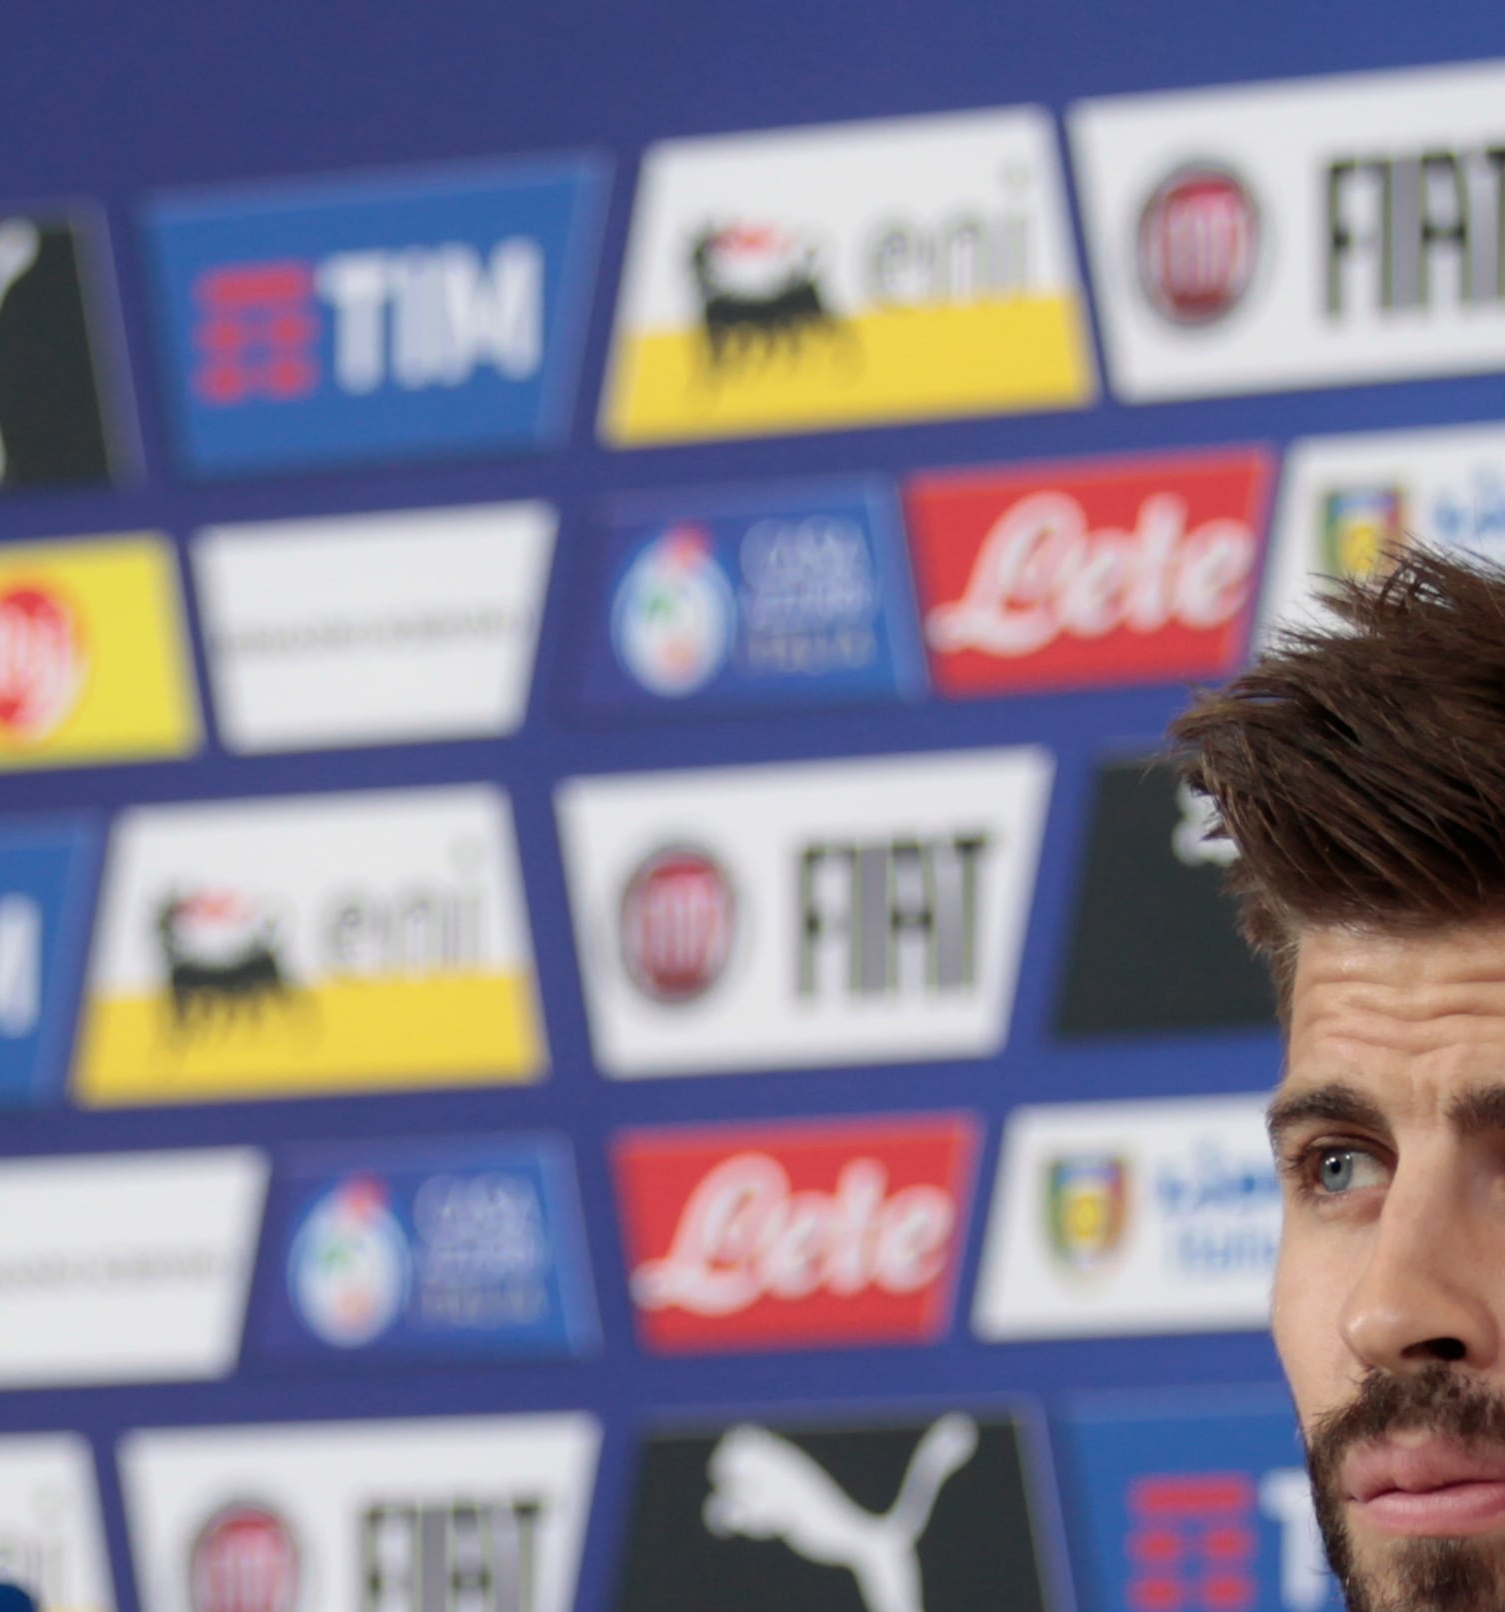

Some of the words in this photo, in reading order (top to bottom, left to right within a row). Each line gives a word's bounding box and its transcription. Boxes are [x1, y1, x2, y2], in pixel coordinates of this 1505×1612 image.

[867, 158, 1033, 305] eni
[319, 236, 544, 395] TIM
[929, 492, 1255, 657] Lete
[799, 832, 995, 1003] FIAT
[629, 1154, 955, 1316] Lete
